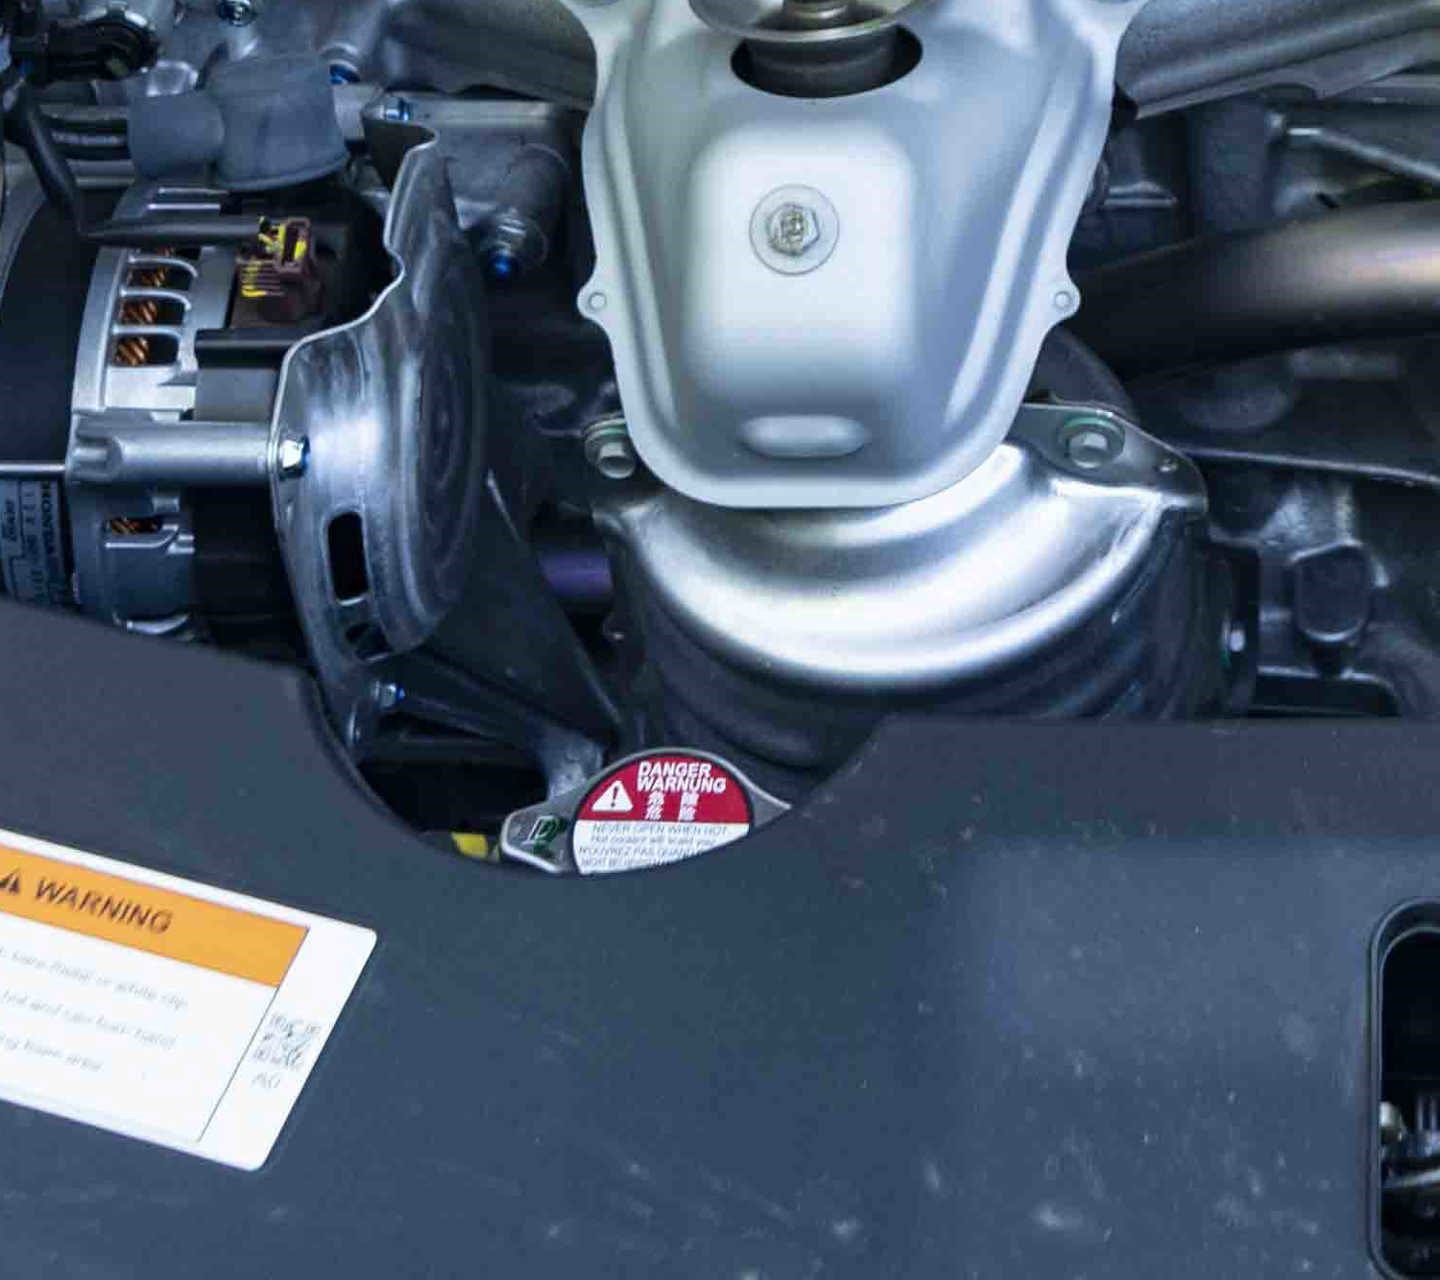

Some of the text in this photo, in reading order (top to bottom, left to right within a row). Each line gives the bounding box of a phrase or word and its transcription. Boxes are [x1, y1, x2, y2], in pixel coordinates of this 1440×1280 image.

[638, 761, 712, 778] DANGER
[636, 776, 727, 794] WARNUNG
[35, 876, 173, 933] WARNING
